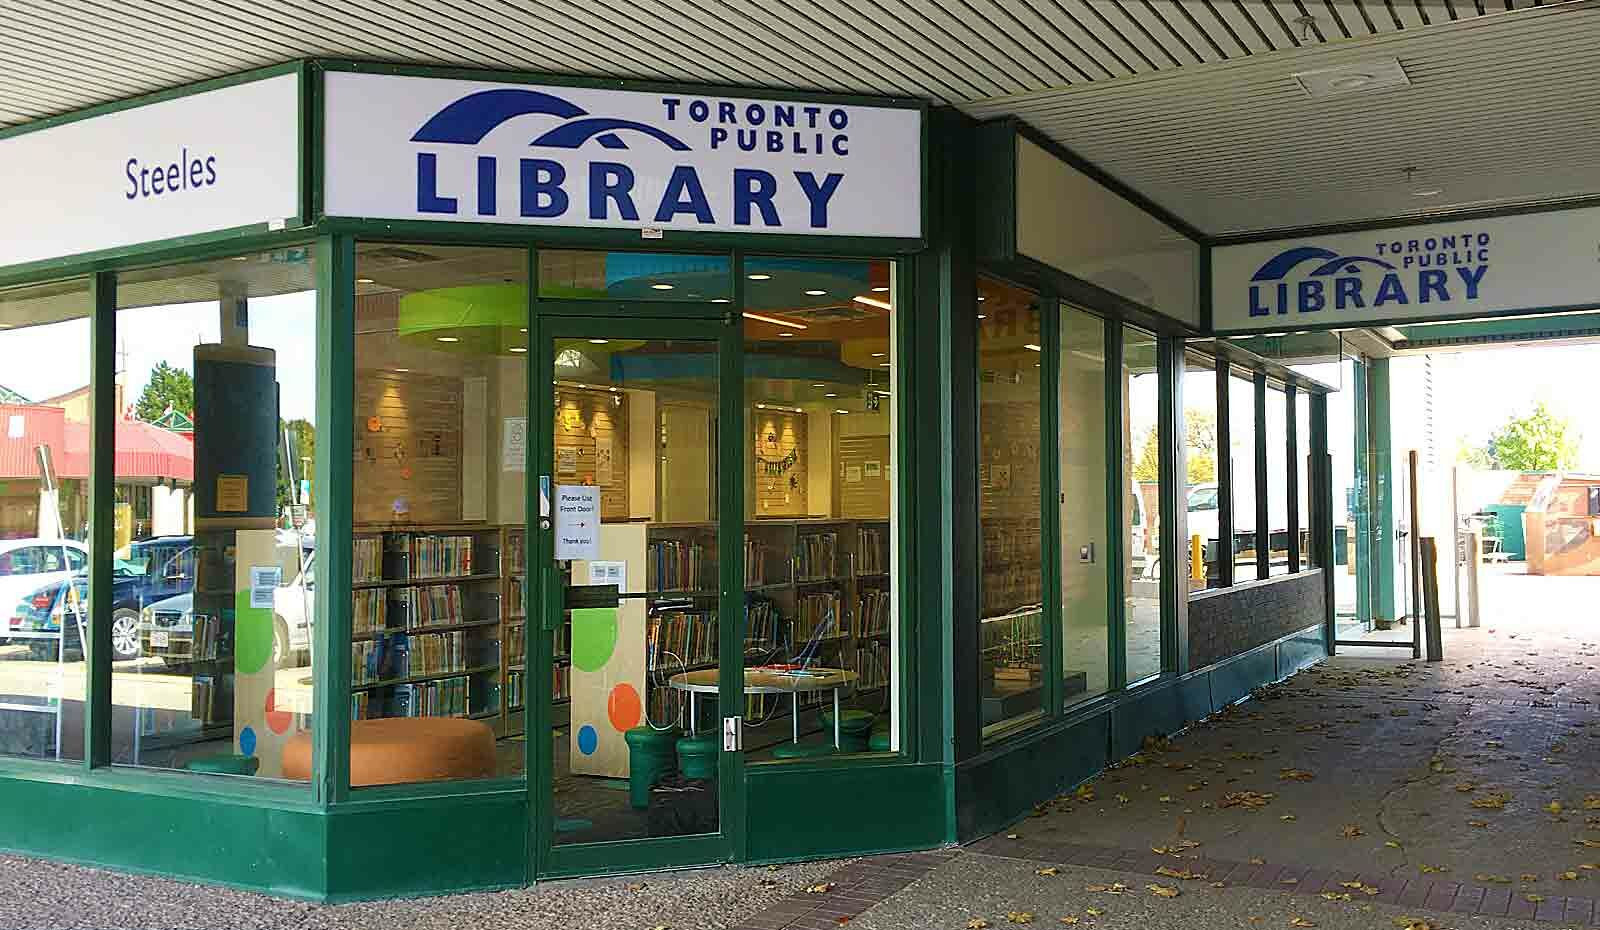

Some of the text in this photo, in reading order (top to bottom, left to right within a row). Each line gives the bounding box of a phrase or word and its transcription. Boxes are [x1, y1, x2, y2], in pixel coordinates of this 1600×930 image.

[662, 98, 849, 130] TORONTO
[710, 127, 849, 156] PUBLIC
[125, 147, 217, 200] Steeles
[416, 153, 845, 229] LIBRARY
[1376, 232, 1491, 256] TORONTO
[1402, 249, 1489, 269] PUBLIC
[1249, 265, 1489, 318] LIBRARY
[560, 505, 594, 513] Front Door!
[561, 494, 580, 502] Please
[562, 537, 579, 545] Thank
